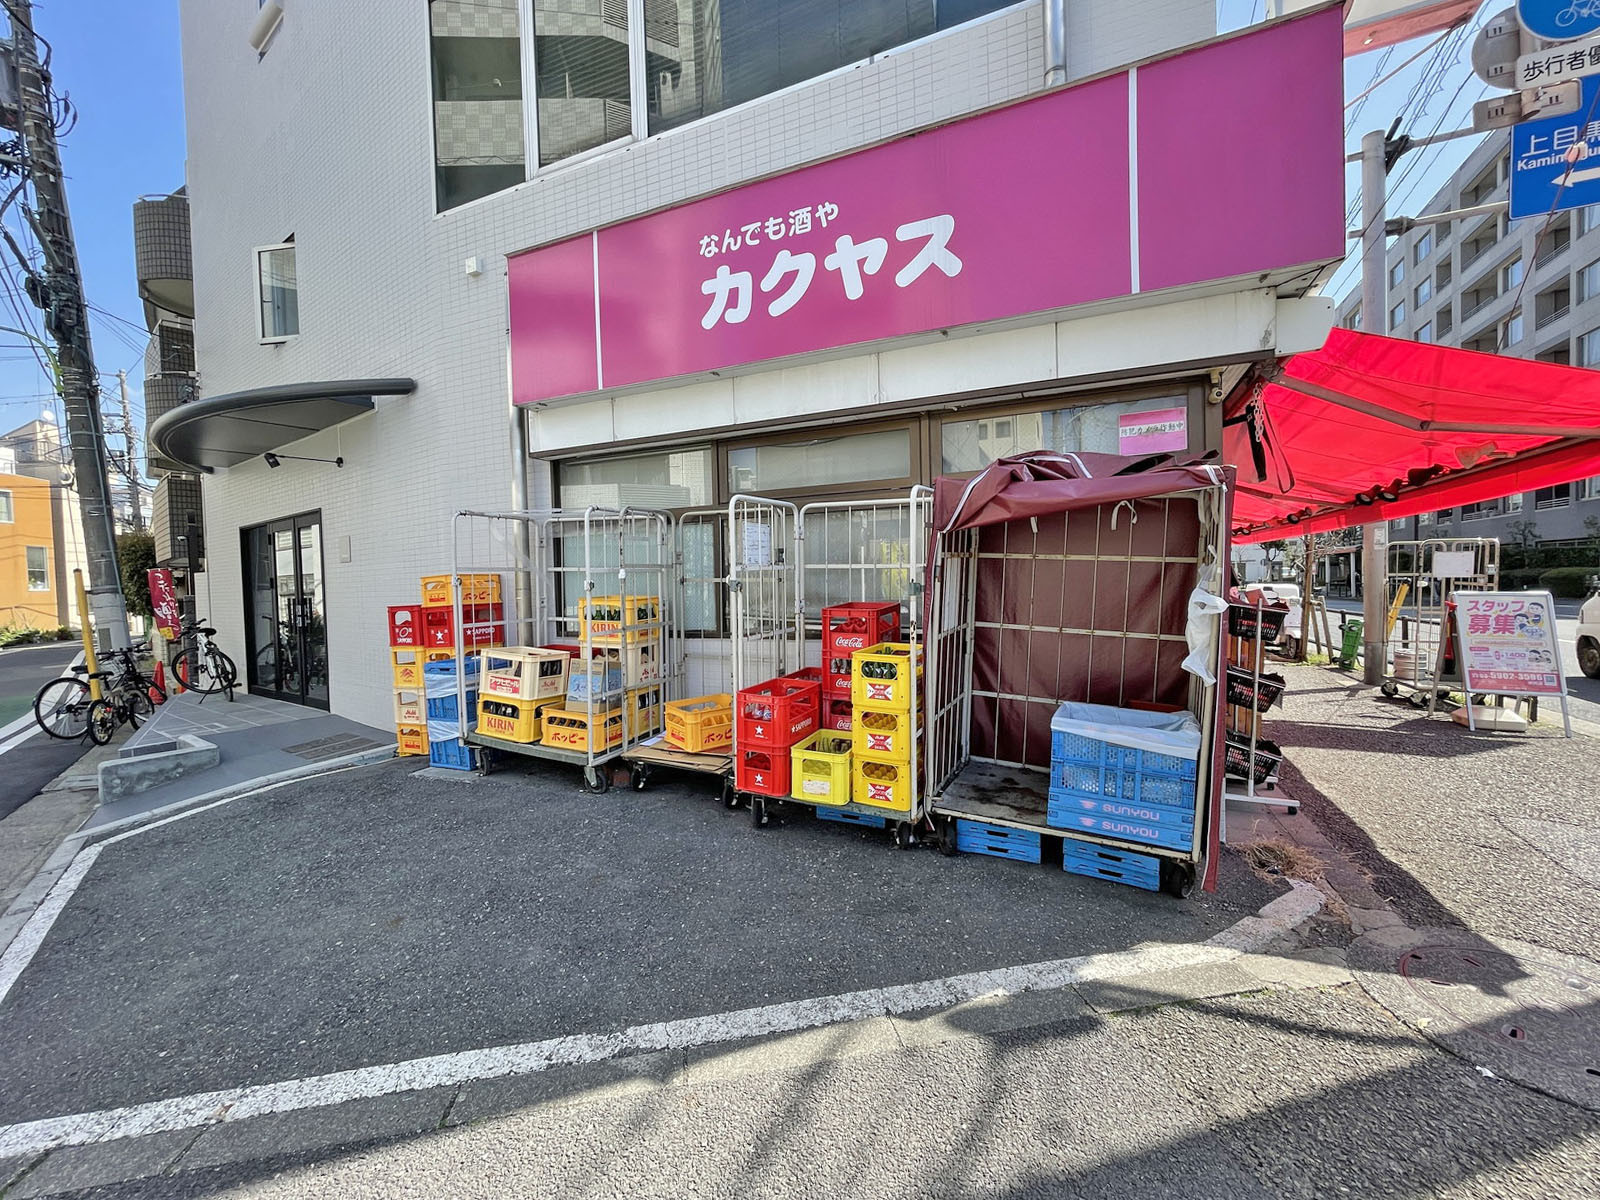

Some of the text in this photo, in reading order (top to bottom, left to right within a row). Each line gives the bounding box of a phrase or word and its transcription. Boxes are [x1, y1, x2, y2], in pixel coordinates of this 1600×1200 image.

[699, 202, 839, 257] なんでも酒や
[701, 215, 963, 330] カクヤス
[1467, 600, 1525, 612] スタッフ
[591, 623, 620, 632] KIRIN
[1468, 614, 1516, 635] 募集
[487, 717, 514, 732] KIRIN
[552, 733, 585, 743] ホッピー
[1102, 803, 1160, 821] SUNYOU
[1101, 821, 1159, 838] SUNYOU
